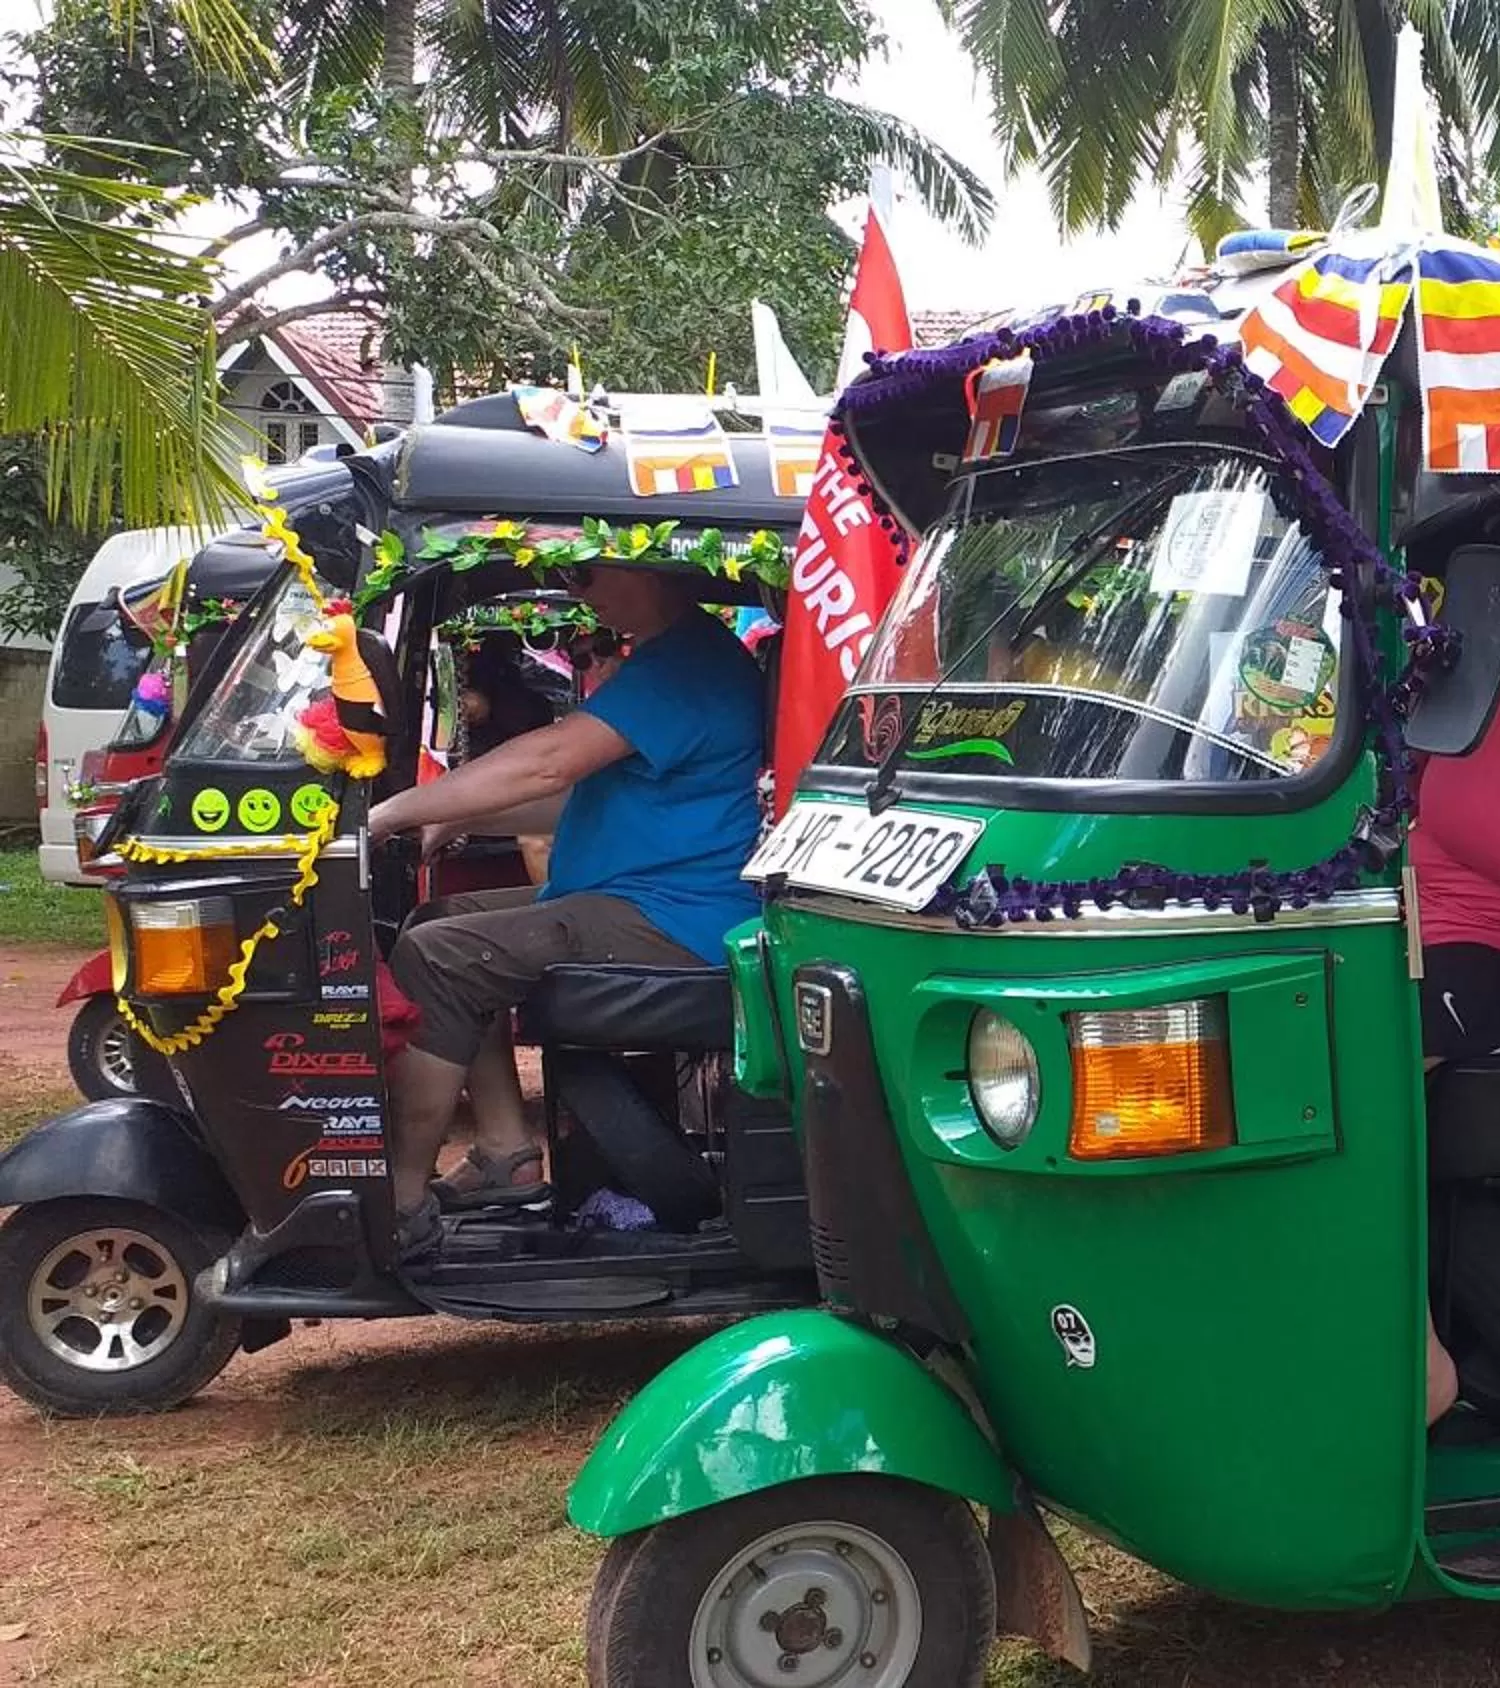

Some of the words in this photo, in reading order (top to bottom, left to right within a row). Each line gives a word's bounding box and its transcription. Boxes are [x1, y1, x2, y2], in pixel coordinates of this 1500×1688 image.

[814, 453, 872, 537] THE
[321, 985, 369, 996] RAYS
[271, 1053, 377, 1067] DIXCEL
[309, 1160, 387, 1176] GREX
[1057, 1313, 1076, 1329] 07
